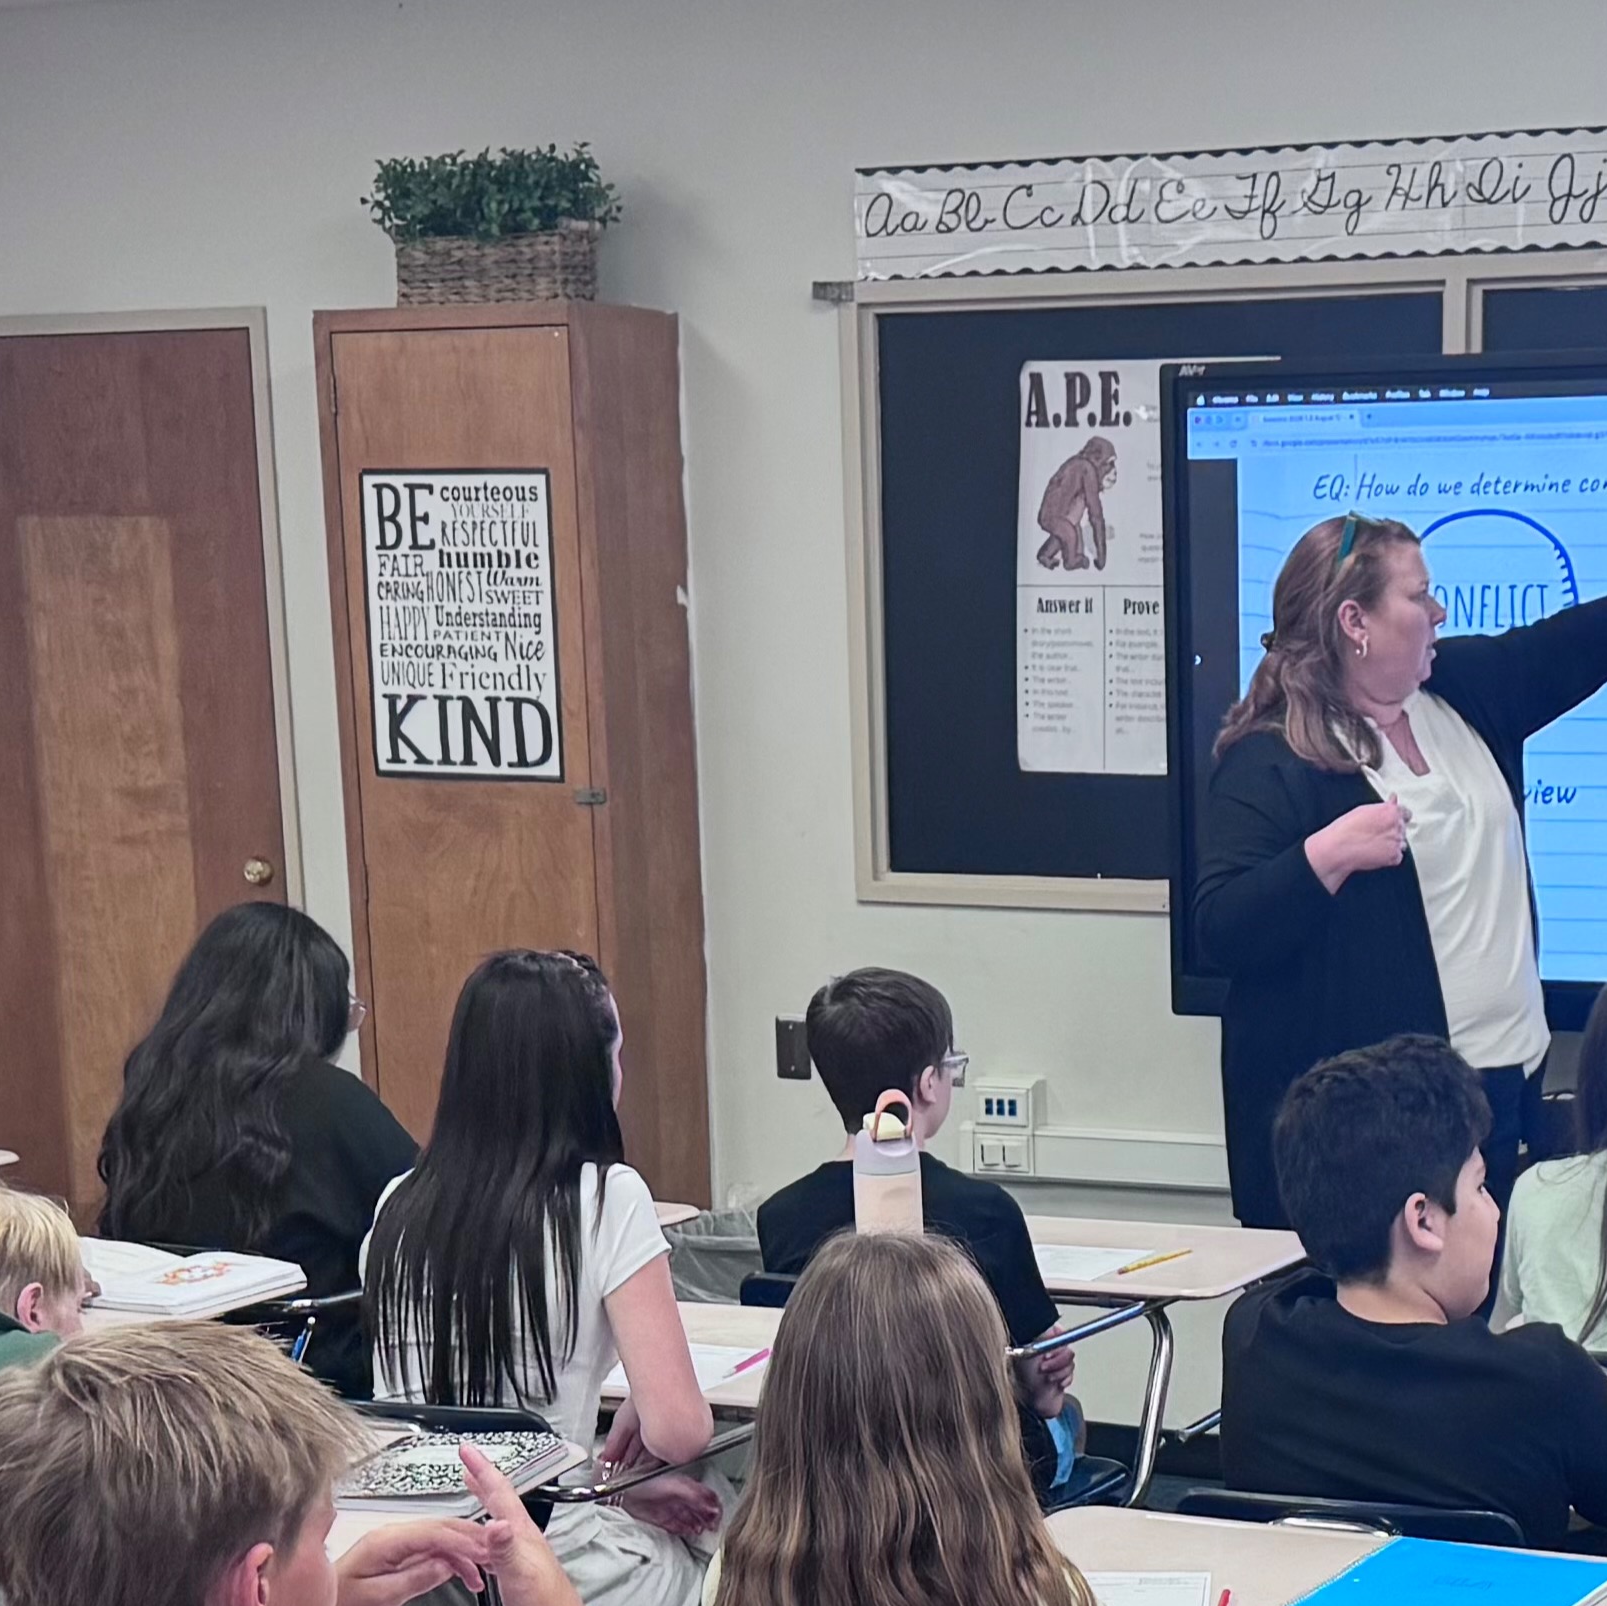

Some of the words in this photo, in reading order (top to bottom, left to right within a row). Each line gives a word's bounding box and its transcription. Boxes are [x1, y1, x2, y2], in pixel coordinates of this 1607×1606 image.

[1024, 370, 1133, 428] A.P.E.
[440, 481, 539, 502] courteous
[1313, 474, 1350, 501] EQ:
[1355, 473, 1400, 500] How
[1407, 473, 1429, 496] do
[1438, 480, 1463, 496] we
[1470, 471, 1572, 497] determine
[372, 482, 436, 551] BE
[450, 502, 531, 519] YOURSELF
[441, 520, 539, 548] RESPECTFUL
[378, 553, 426, 578] FAIR
[438, 549, 540, 570] humble
[485, 568, 542, 588] Warm
[377, 580, 425, 602] CARING
[426, 570, 484, 604] HONEST
[485, 589, 544, 606] SWEET
[1037, 597, 1082, 614] Answer
[1123, 598, 1160, 615] Prove
[1435, 584, 1549, 628] ONFLICT
[380, 605, 430, 642] HAPPY
[434, 605, 542, 635] Understanding
[380, 642, 498, 662] ENCOURAGING
[433, 630, 504, 642] PATIENT
[504, 631, 545, 661] Nice
[381, 660, 434, 689] UNIQUE
[441, 662, 547, 700] Friendly
[382, 692, 553, 769] KIND
